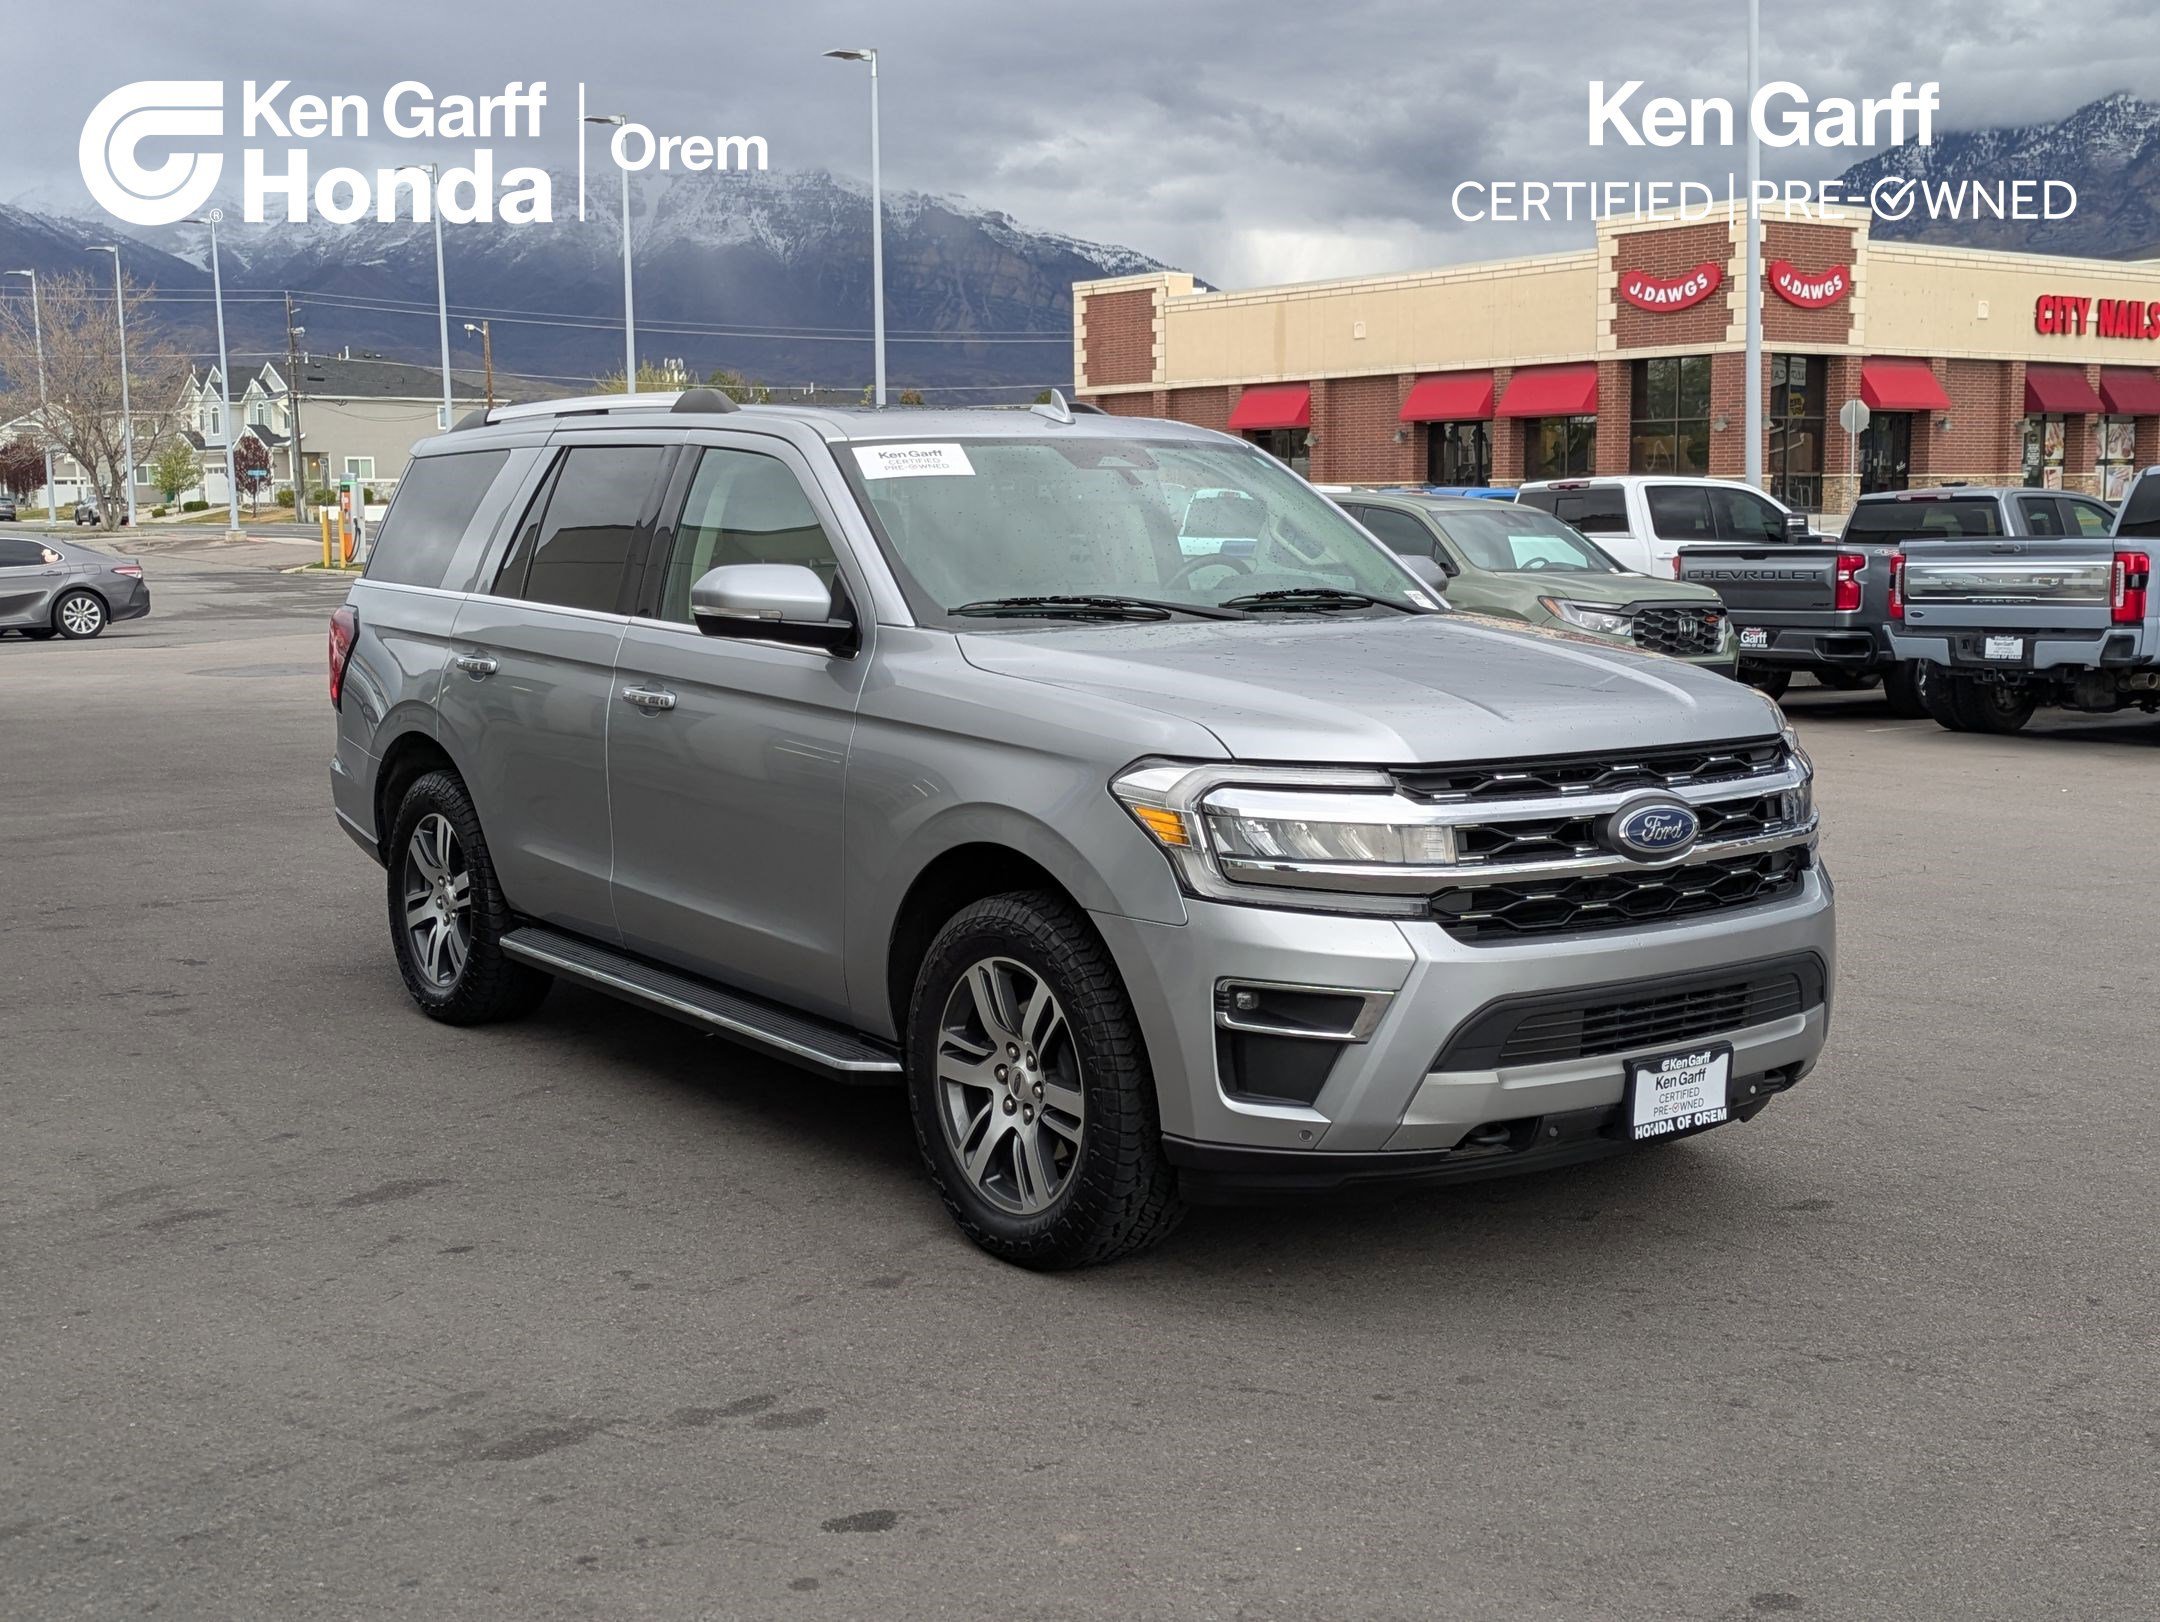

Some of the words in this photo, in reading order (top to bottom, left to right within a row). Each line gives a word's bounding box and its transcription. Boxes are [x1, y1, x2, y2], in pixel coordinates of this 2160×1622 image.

[1629, 273, 1708, 303] J.DAWGS
[1780, 273, 1843, 300] J.DAWGS
[2035, 295, 2092, 335] CITY
[2096, 298, 2160, 340] NAILS
[878, 451, 907, 459] Ken
[909, 450, 943, 458] Garff
[888, 457, 941, 465] CERTIFIED
[1687, 570, 1823, 580] CHEVROLET
[1740, 631, 1767, 644] Garff
[1641, 815, 1684, 842] Ford
[1670, 1055, 1689, 1070] Ken
[1688, 1051, 1712, 1066] Garff
[1655, 1074, 1677, 1091] Ken
[1678, 1067, 1707, 1087] Garff
[1659, 1086, 1700, 1104] CERTIFIED
[1635, 1120, 1675, 1140] HONDA
[1677, 1115, 1692, 1130] OF
[1695, 1107, 1727, 1126] OREM
